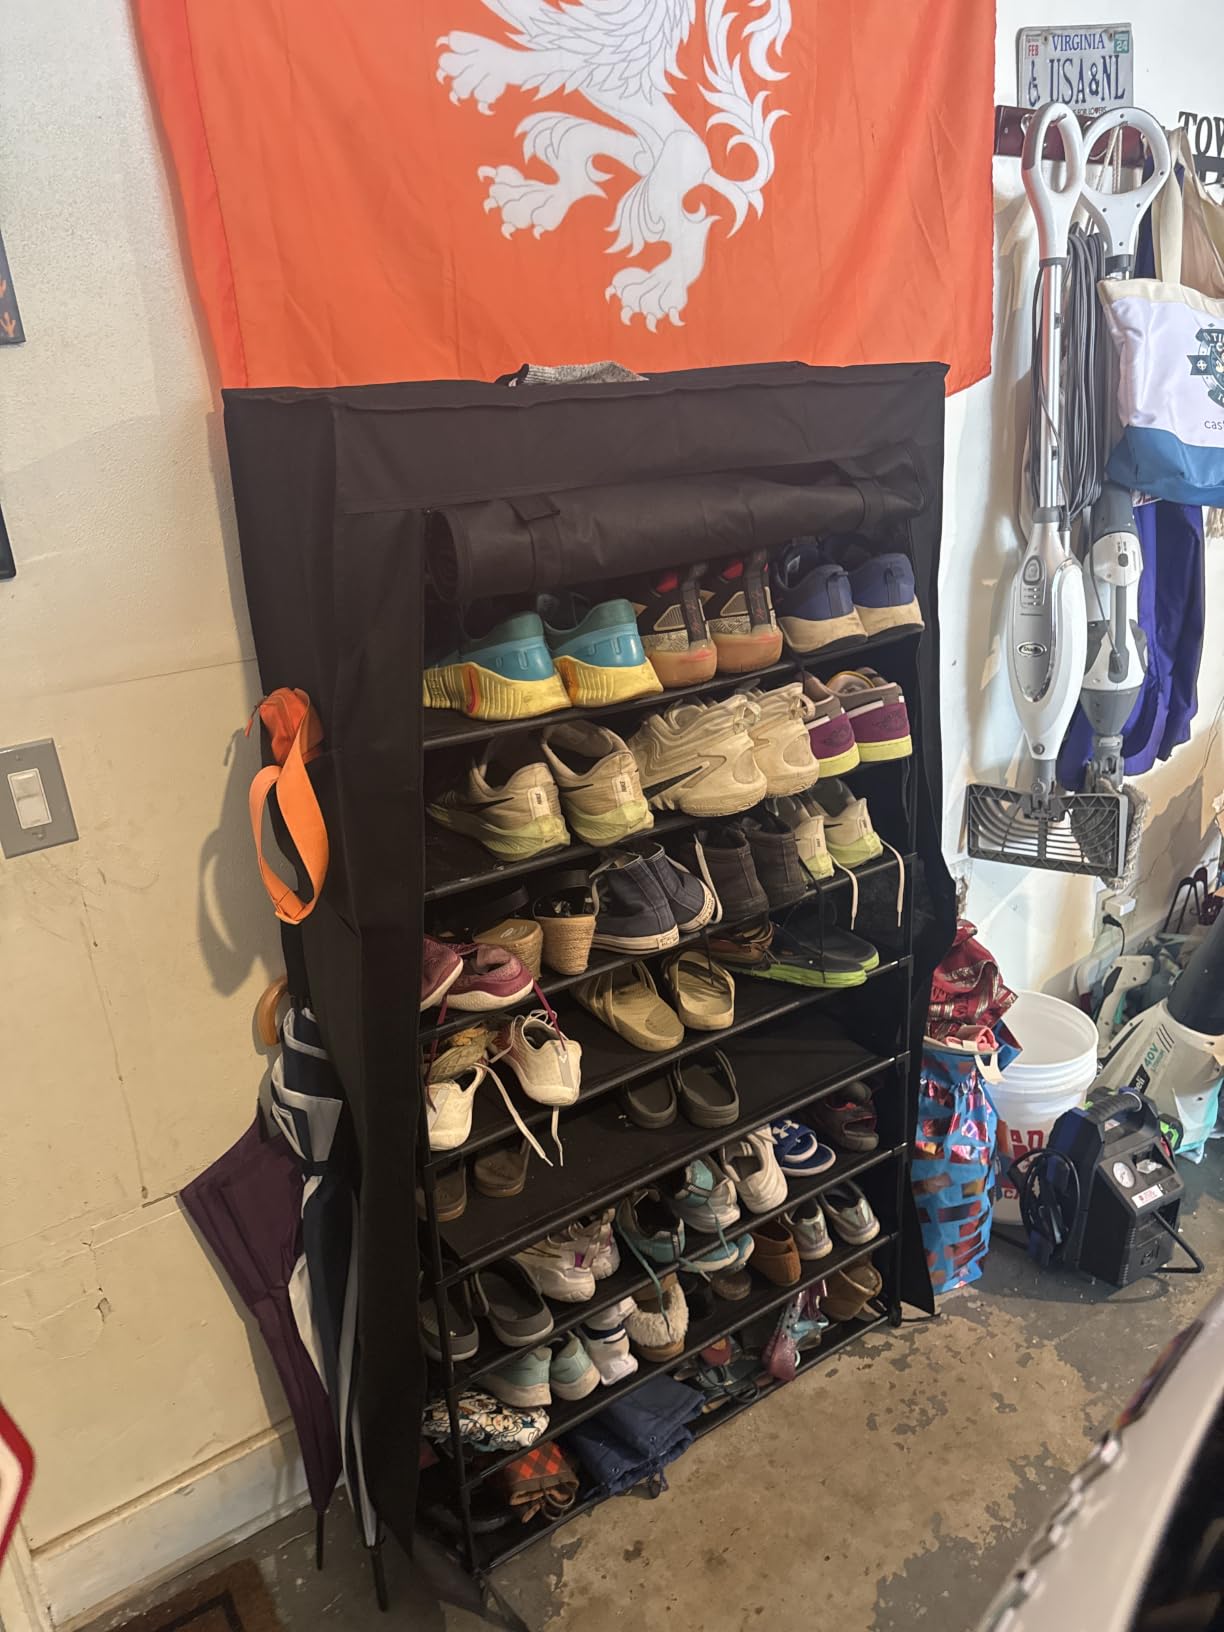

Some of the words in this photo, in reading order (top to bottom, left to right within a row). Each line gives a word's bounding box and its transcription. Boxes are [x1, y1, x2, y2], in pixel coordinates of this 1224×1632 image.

[1028, 44, 1039, 56] FEB
[1052, 32, 1105, 52] VIRGINIA
[1116, 40, 1129, 52] 24
[1049, 55, 1126, 104] USA&NL
[1144, 1042, 1159, 1067] 40V
